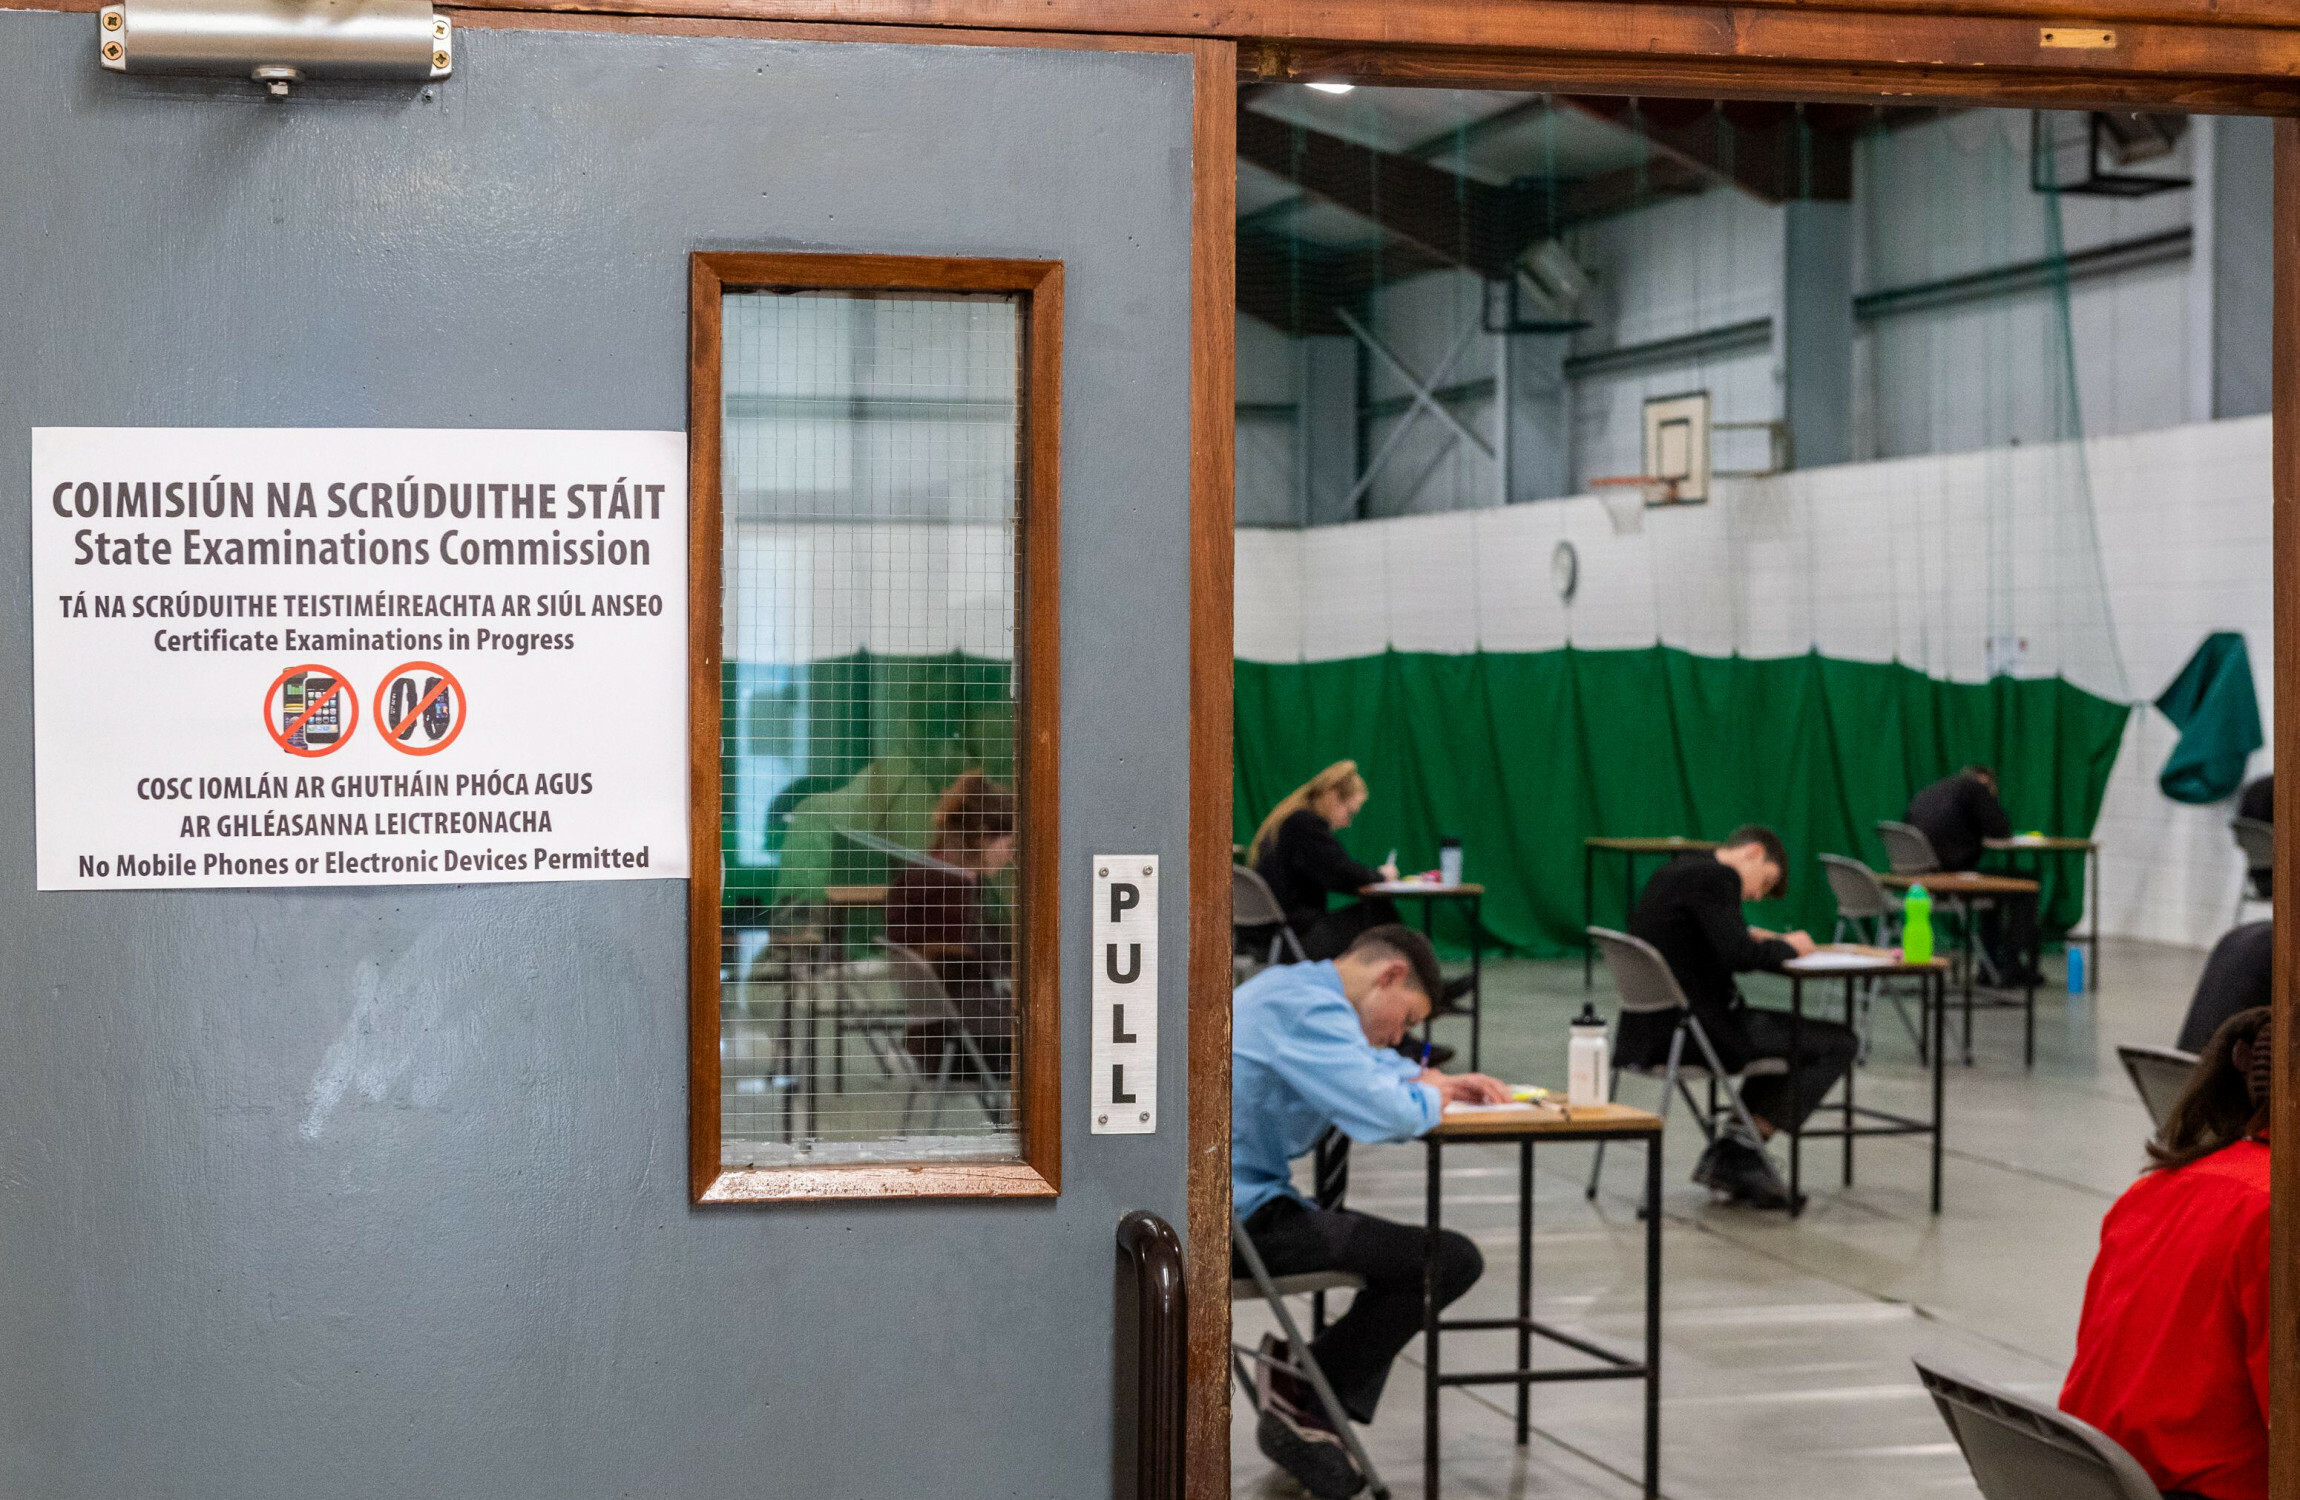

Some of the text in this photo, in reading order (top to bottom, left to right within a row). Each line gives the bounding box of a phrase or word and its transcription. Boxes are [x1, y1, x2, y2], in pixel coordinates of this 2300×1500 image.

[53, 475, 665, 519] COIMISIÚN NA SCRÚDUITHE STÁIT
[75, 529, 649, 565] State Examinations Commission
[60, 590, 662, 617] TÁ NA SCRÚDUITHE TEISTIMÉIREACHTA AR SIÚL ANSEO
[155, 628, 574, 655] Certificate Examinations in Progress
[138, 769, 592, 800] COSC IOMLÁN AR GHUTHÁIN PHÓCA AGUS
[180, 810, 552, 837] AR GHLÉASANNA LEICTREONACHA
[80, 846, 648, 877] No Mobile Phones or Electronic Devices Permitted
[1106, 883, 1141, 1103] PULL
